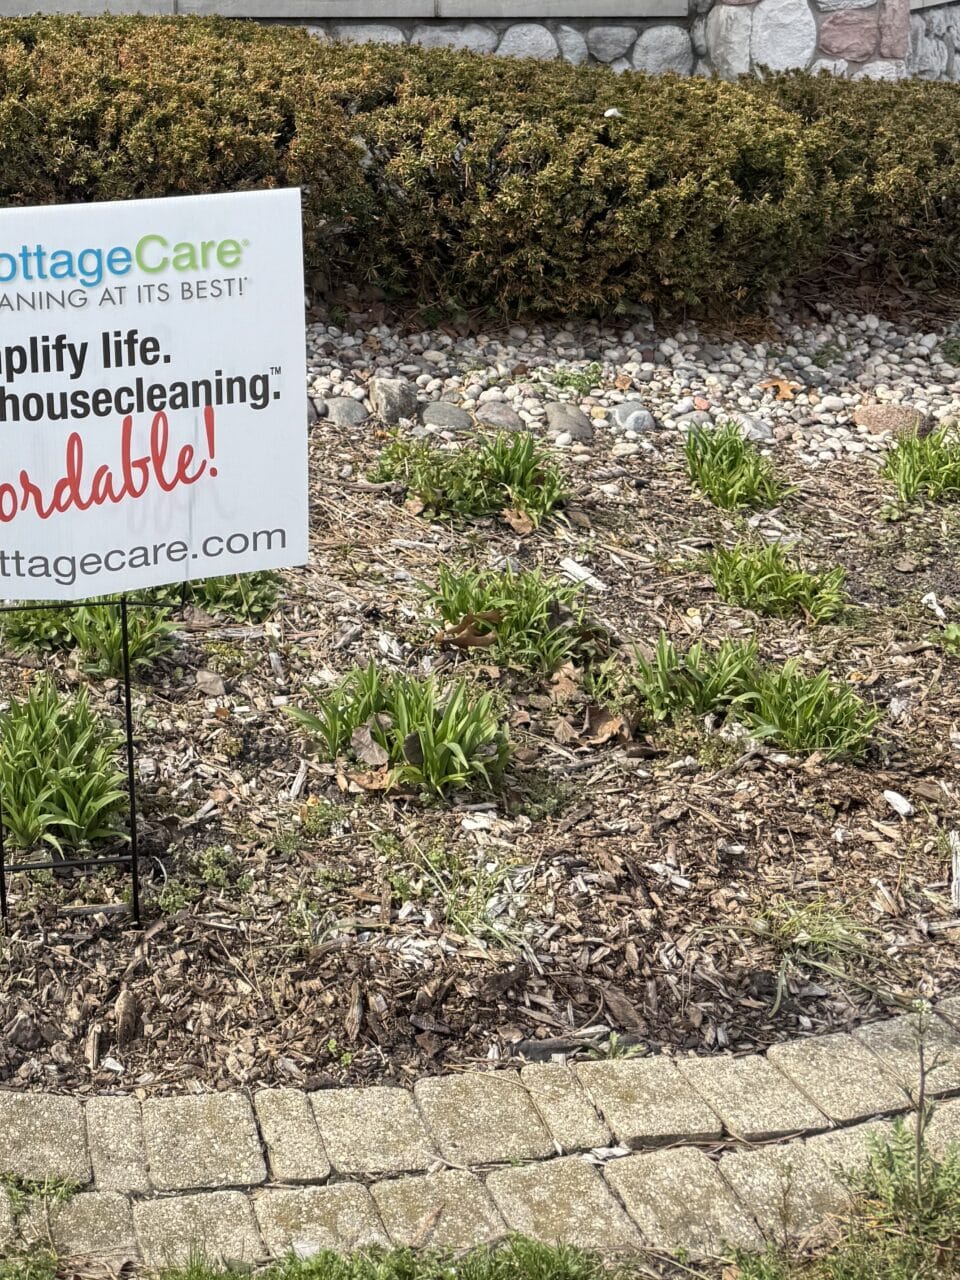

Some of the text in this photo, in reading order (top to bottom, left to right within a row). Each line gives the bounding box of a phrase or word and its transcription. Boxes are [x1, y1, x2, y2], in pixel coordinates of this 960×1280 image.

[98, 285, 127, 306] AT
[137, 283, 170, 303] ITS
[101, 329, 172, 369] life.
